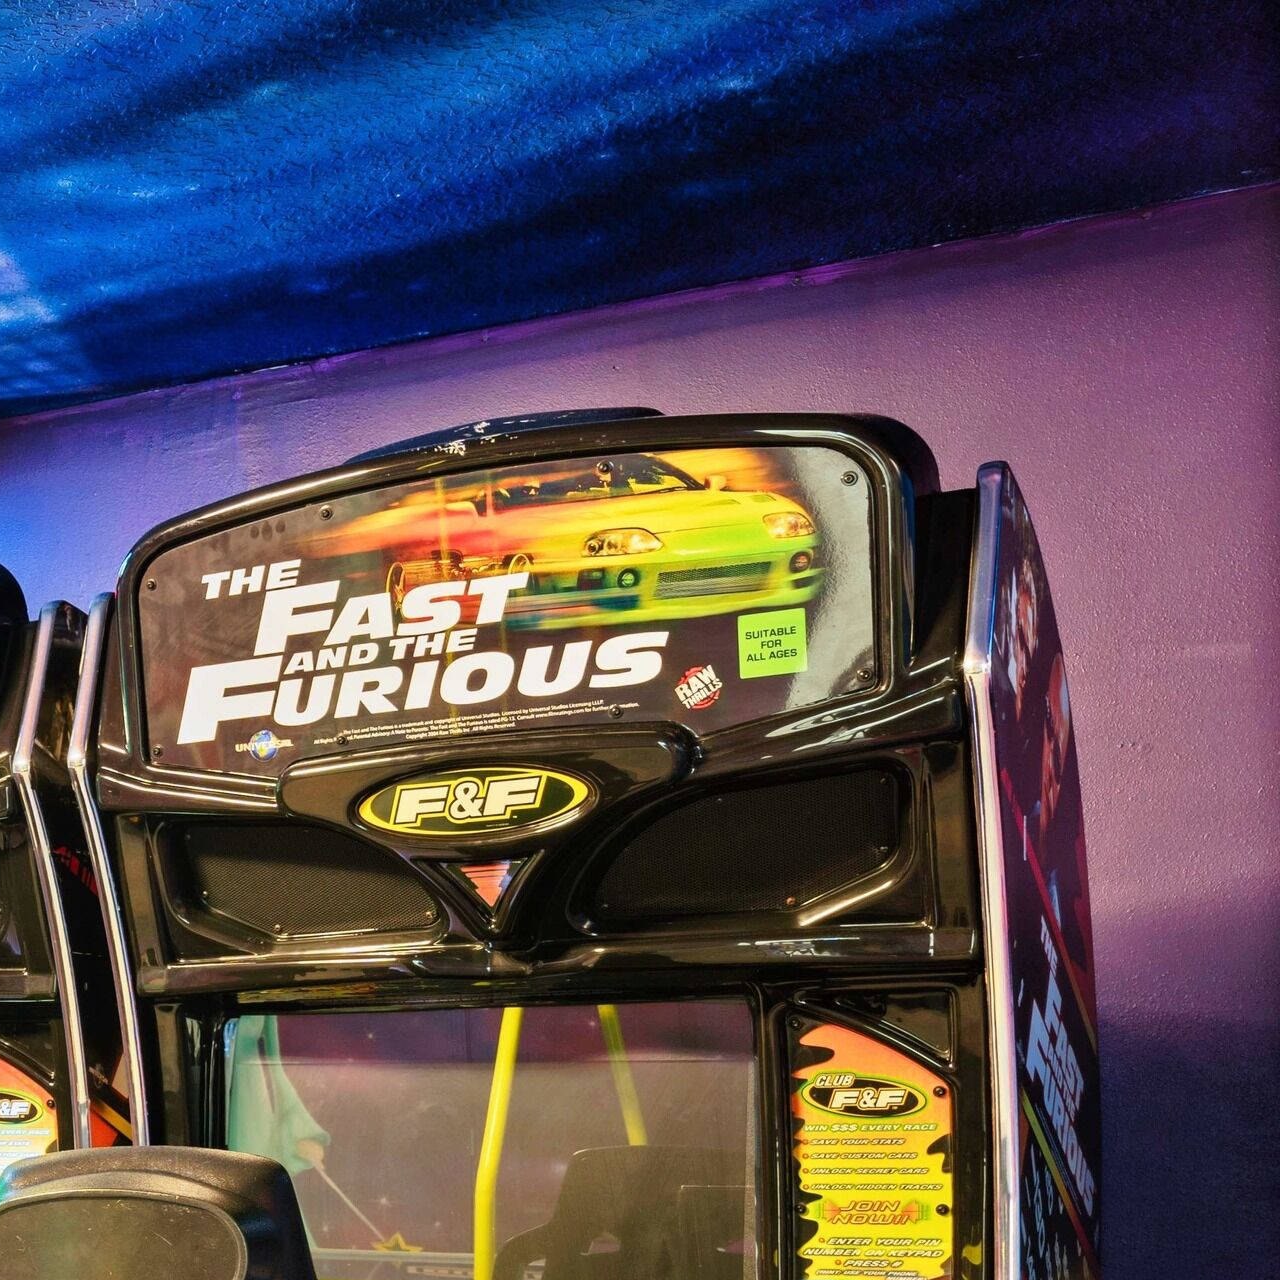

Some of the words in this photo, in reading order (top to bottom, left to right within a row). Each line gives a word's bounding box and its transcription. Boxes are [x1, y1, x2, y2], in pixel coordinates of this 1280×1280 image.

[201, 559, 301, 600] THE
[253, 573, 530, 655] FAST
[745, 626, 797, 639] SUITABLE
[760, 639, 782, 649] FOR
[283, 643, 380, 675] AND
[388, 628, 478, 661] THE
[746, 653, 766, 662] ALL
[768, 649, 798, 660] AGES
[176, 631, 670, 745] FURIOUS
[674, 664, 717, 701] RAW
[682, 678, 723, 710] THRILLS
[394, 776, 541, 825] F&F
[815, 1075, 854, 1087] CLUB
[830, 1088, 906, 1109] F&F
[804, 1124, 828, 1132] WIN
[830, 1124, 858, 1132] $$$
[861, 1124, 900, 1132] EVERY
[904, 1124, 938, 1132] RACE
[840, 1200, 900, 1212] JOIN
[828, 1238, 872, 1246] ENTER
[876, 1238, 912, 1246] YOUR
[916, 1238, 942, 1246] PIN
[804, 1249, 861, 1257] NUMBER
[864, 1249, 886, 1257] ON
[888, 1249, 944, 1257] KEYPAD
[844, 1260, 890, 1268] PRESS
